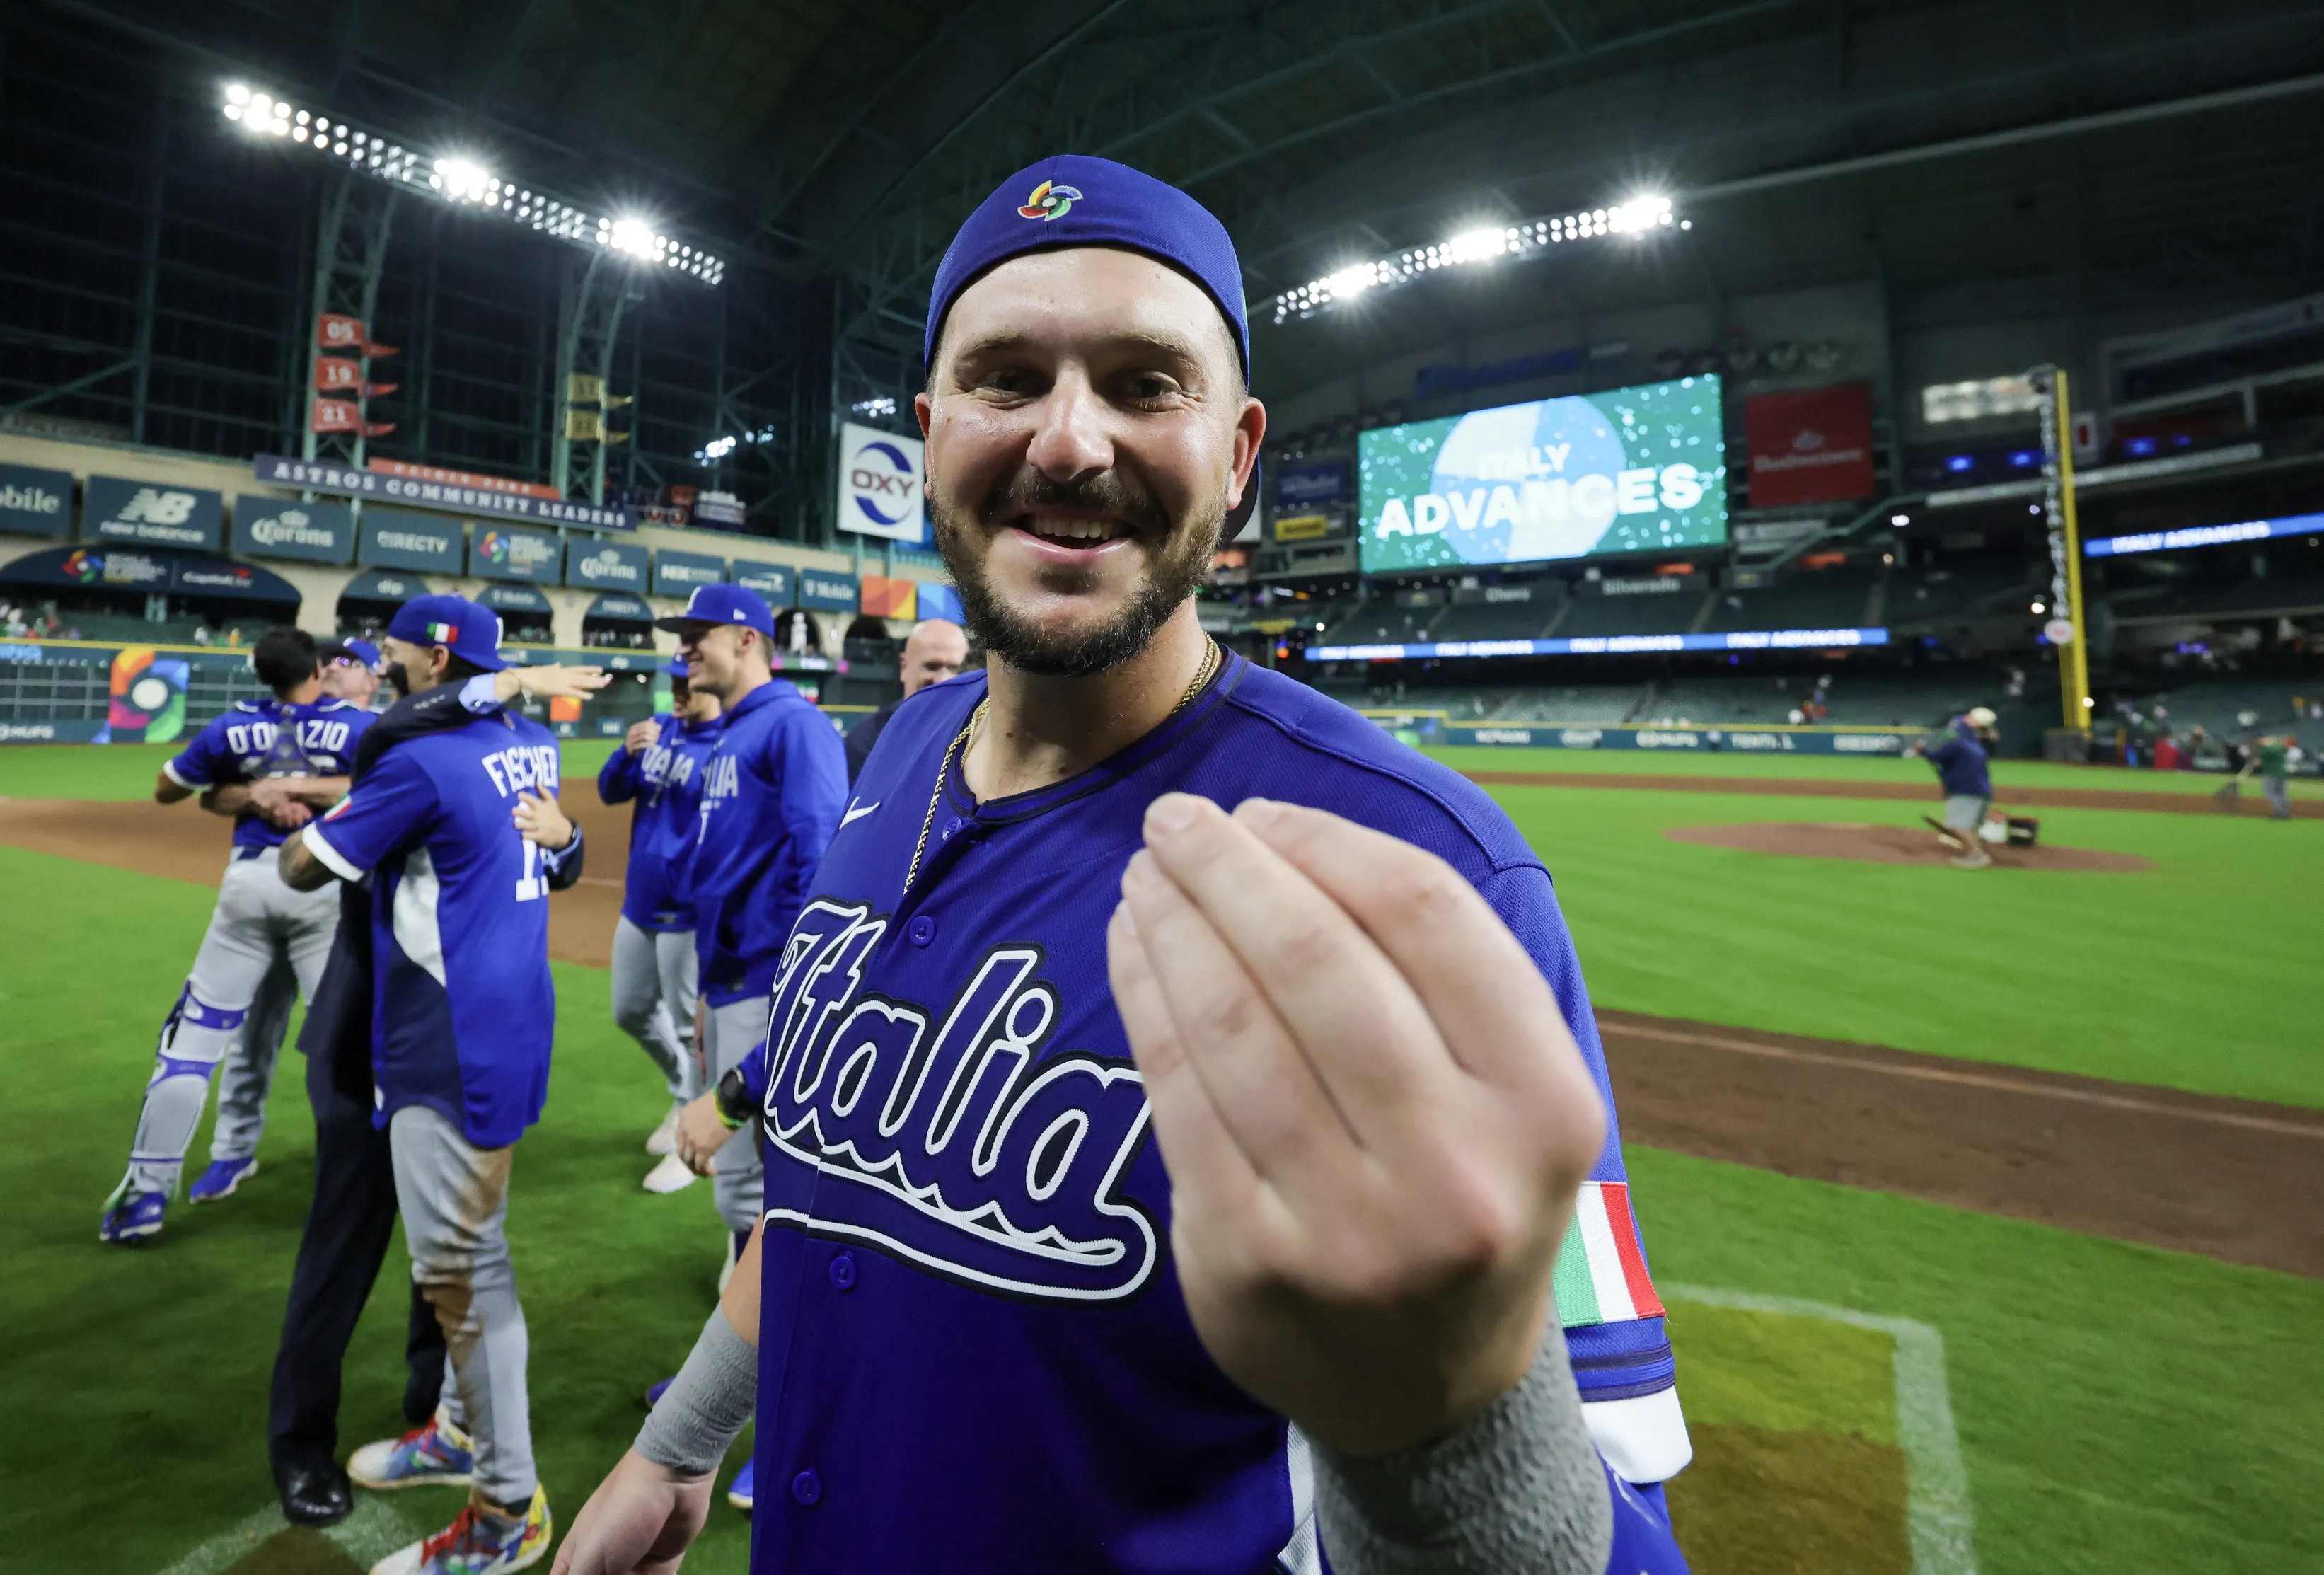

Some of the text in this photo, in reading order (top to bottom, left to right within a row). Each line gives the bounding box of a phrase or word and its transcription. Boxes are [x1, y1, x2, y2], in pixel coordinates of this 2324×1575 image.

[322, 405, 346, 422] 21
[1476, 442, 1571, 482] ITALY
[0, 483, 60, 514] bile
[274, 461, 627, 528] ASTROS COMMUNITY LEADERS
[851, 468, 915, 499] OXY
[1375, 463, 1704, 539] ADVANCES
[250, 517, 335, 548] Corona
[377, 531, 449, 555] DIRECTV
[764, 895, 1157, 1302] Italia
